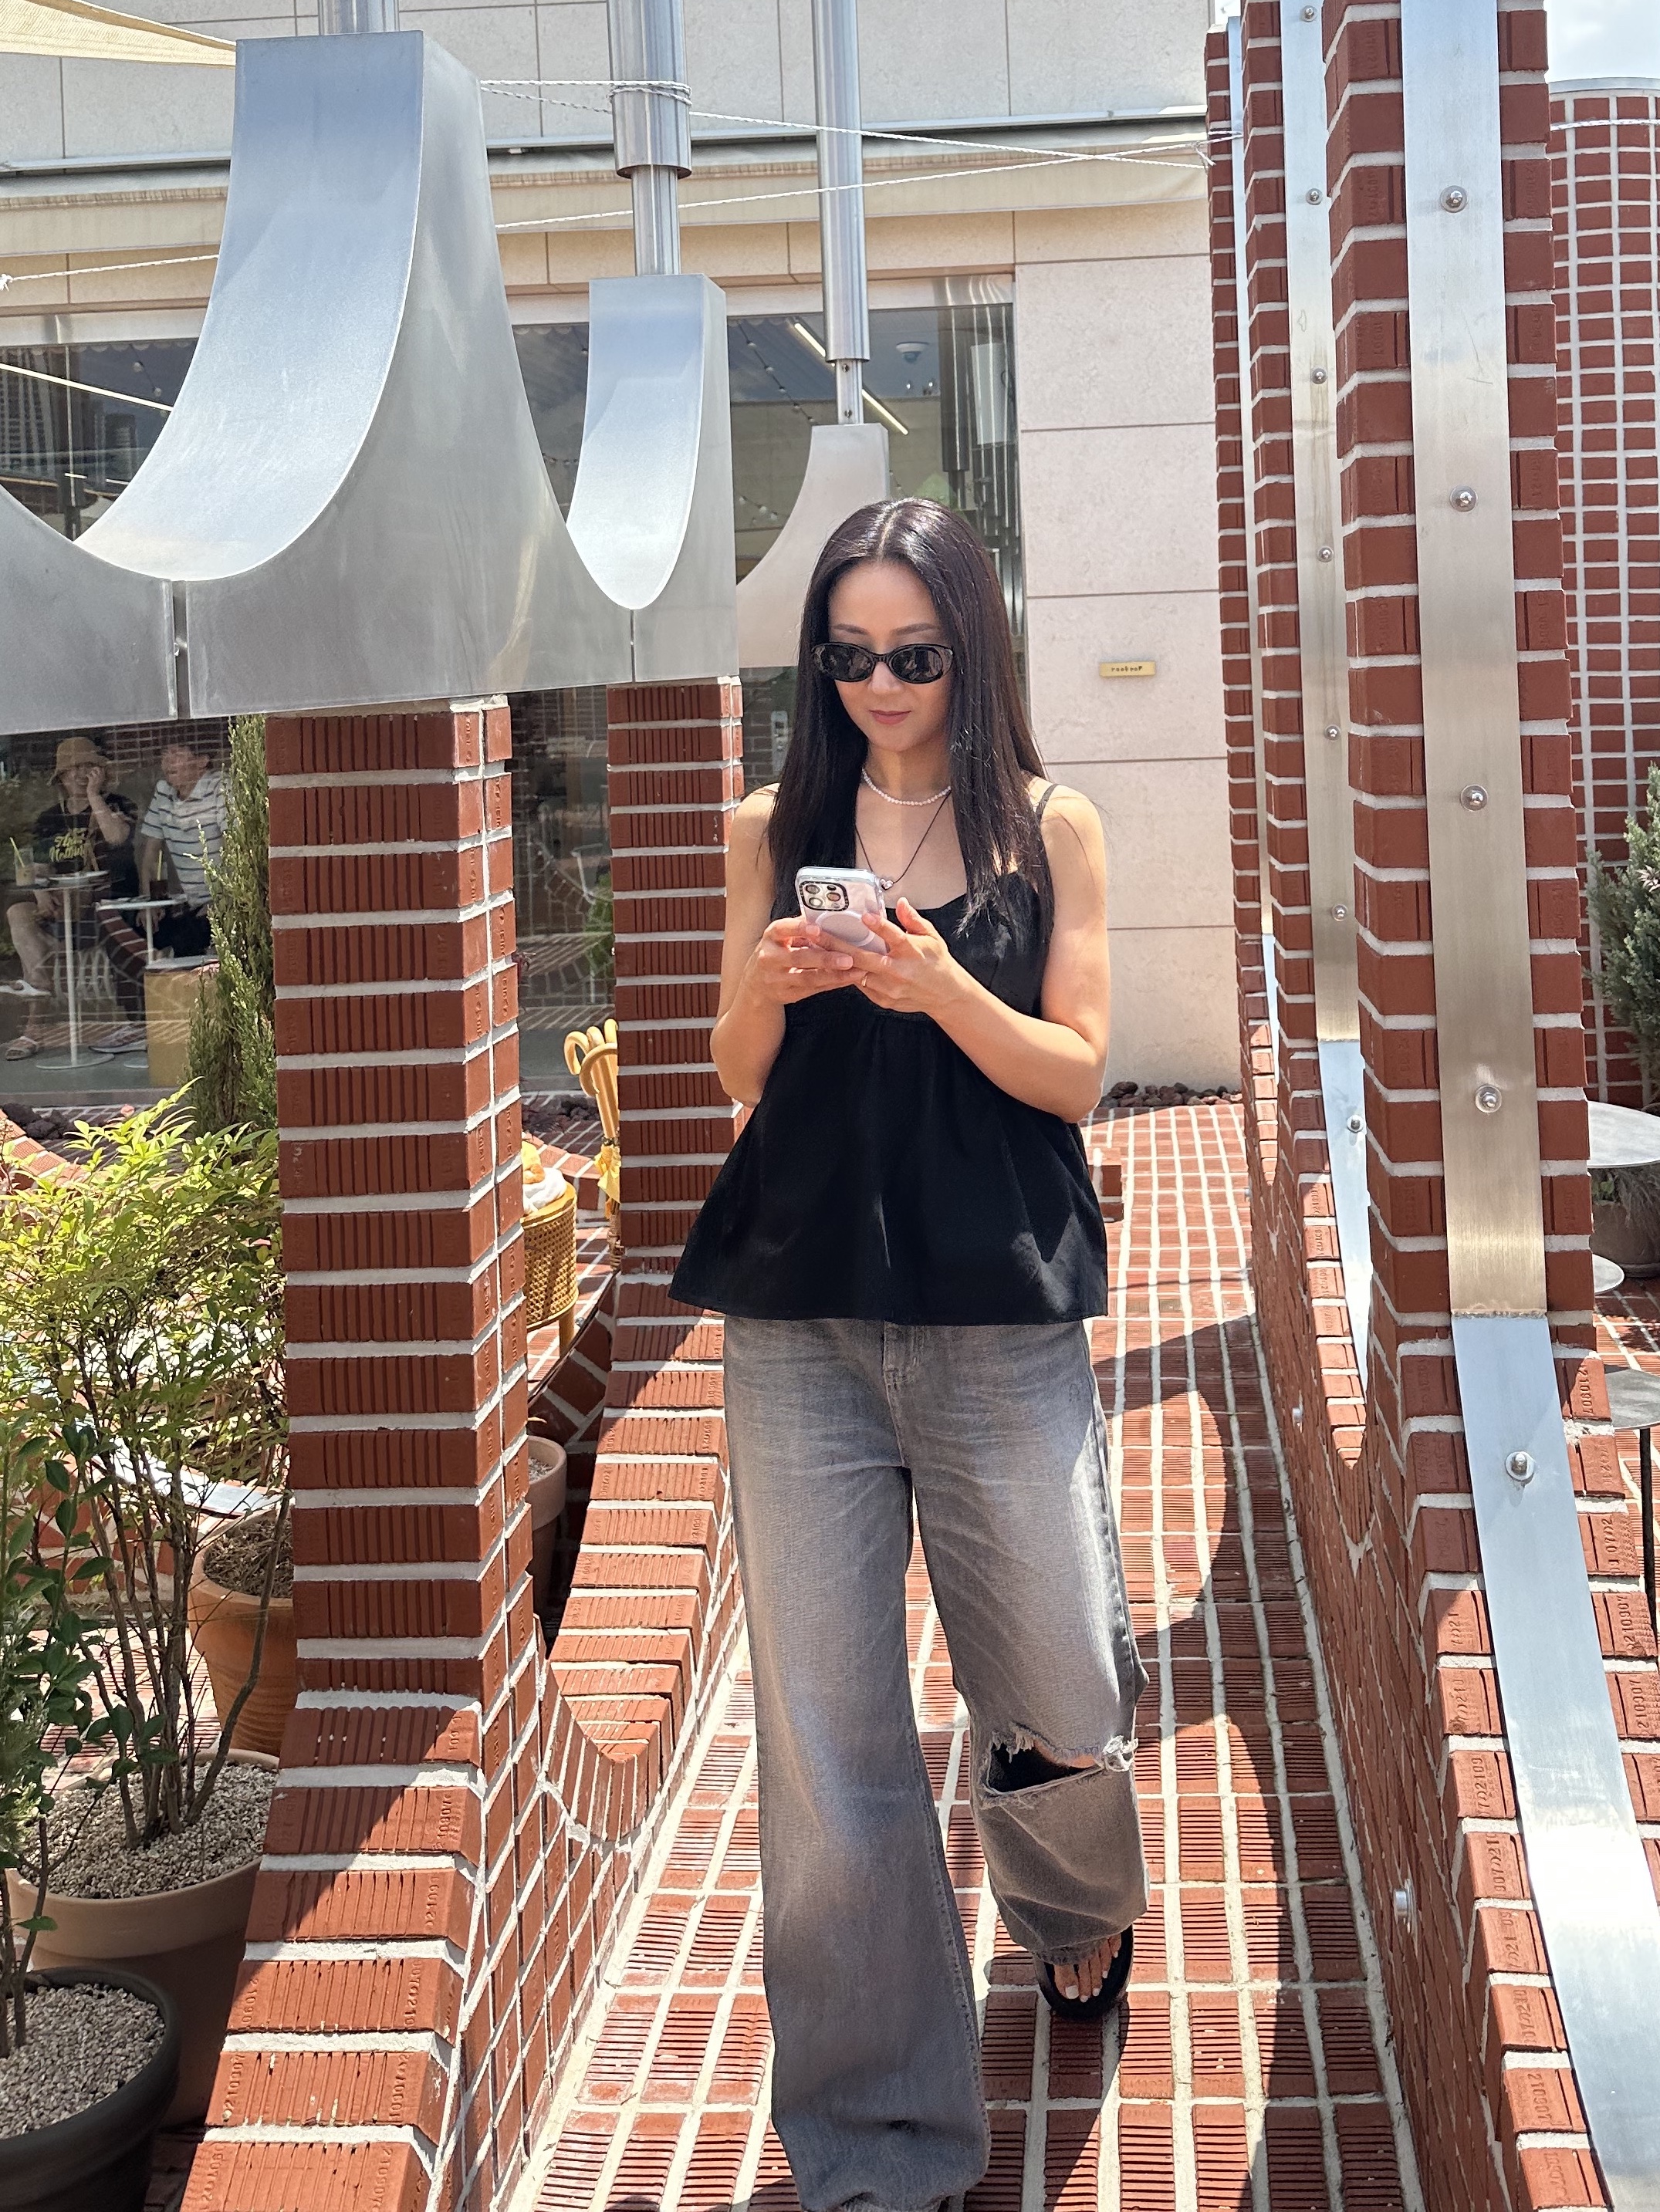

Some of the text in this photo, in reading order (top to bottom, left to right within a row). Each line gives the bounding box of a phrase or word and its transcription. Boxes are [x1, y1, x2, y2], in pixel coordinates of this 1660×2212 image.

[1579, 1366, 1594, 1416] 210907
[1618, 1595, 1636, 1649] 210907
[1630, 1679, 1650, 1730] 210907
